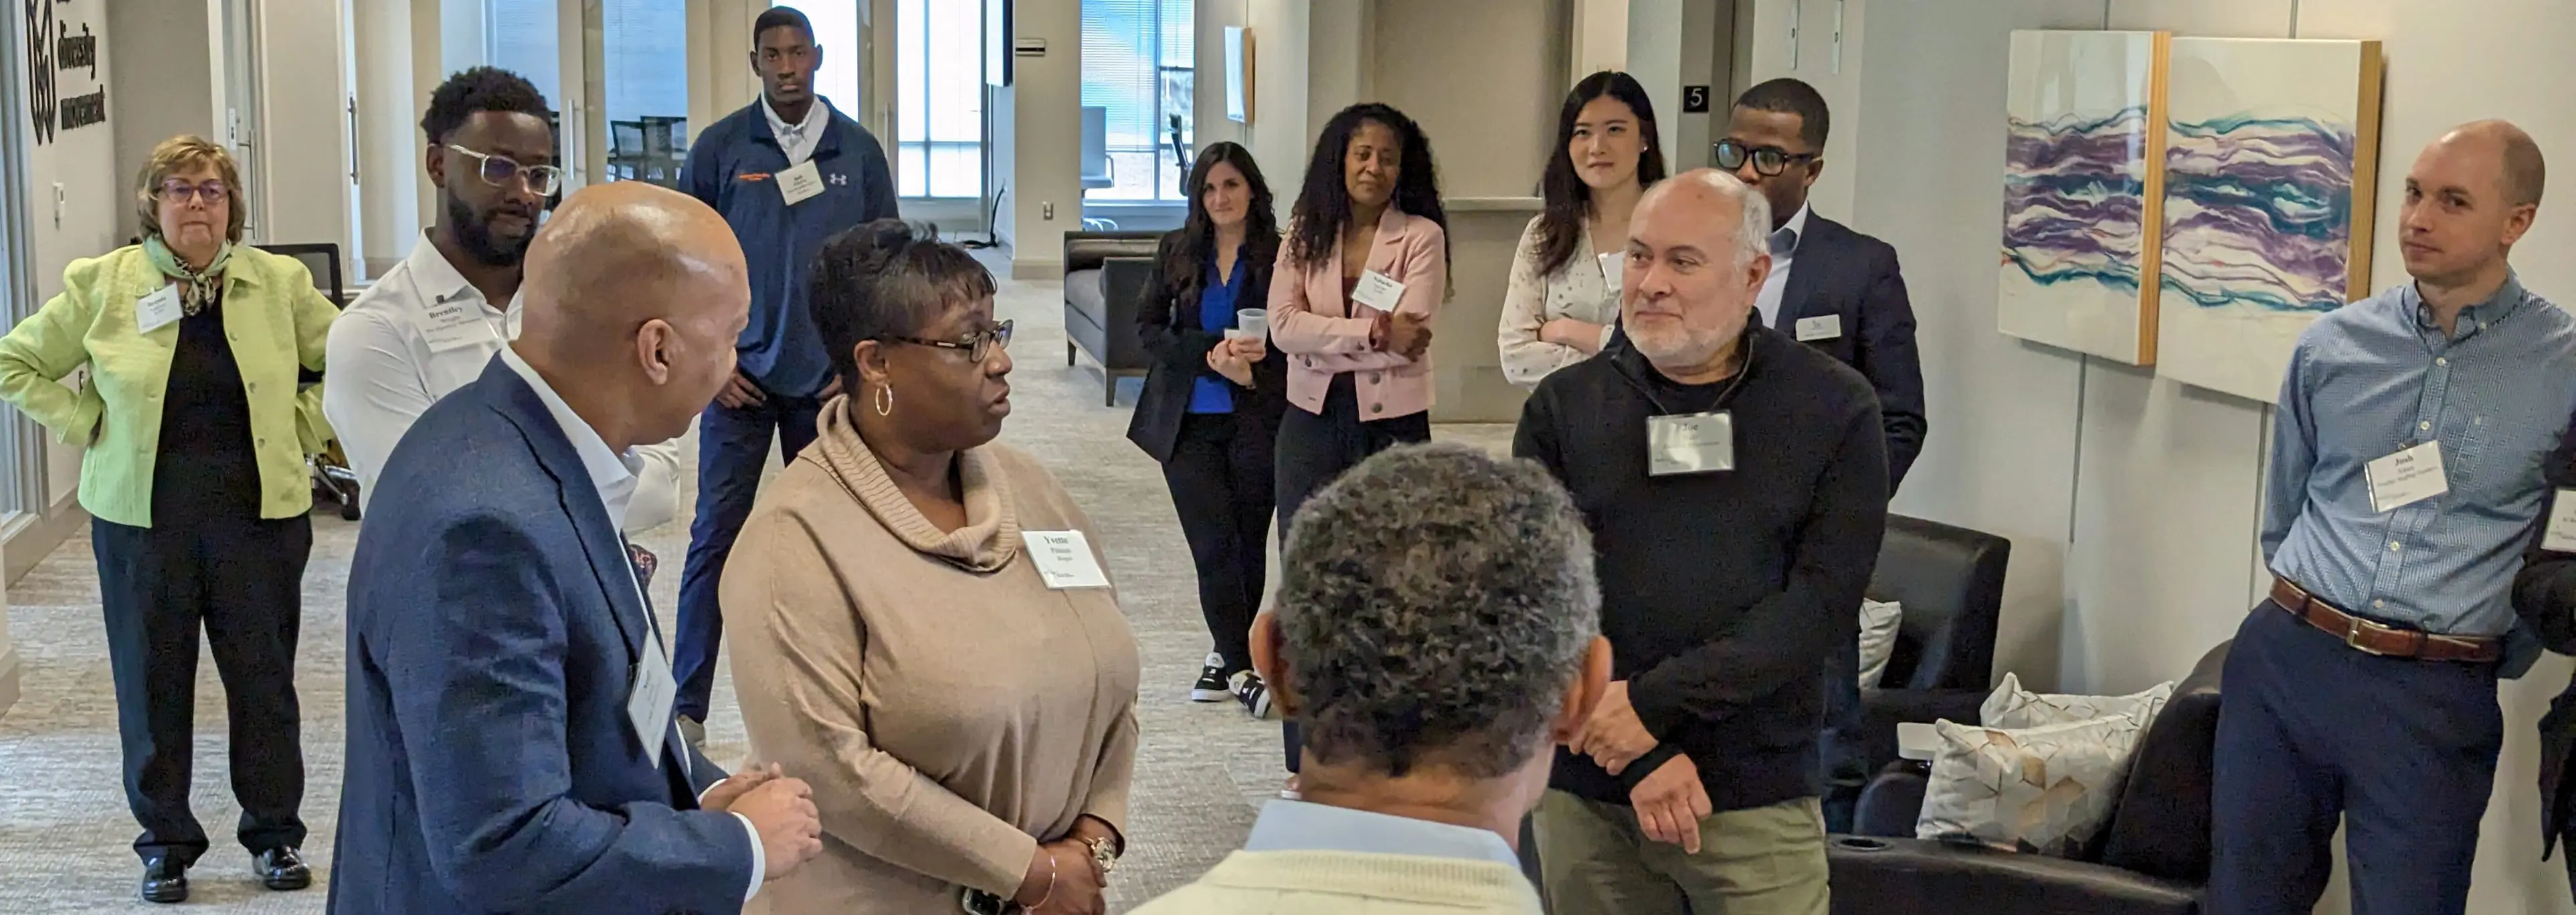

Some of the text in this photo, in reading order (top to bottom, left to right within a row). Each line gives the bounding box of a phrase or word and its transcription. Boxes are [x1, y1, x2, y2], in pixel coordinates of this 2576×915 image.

[57, 19, 96, 80] diversity
[1689, 88, 1703, 107] 5
[60, 84, 106, 131] movement
[2395, 454, 2414, 467] Josh
[1043, 535, 1069, 544] Yvette
